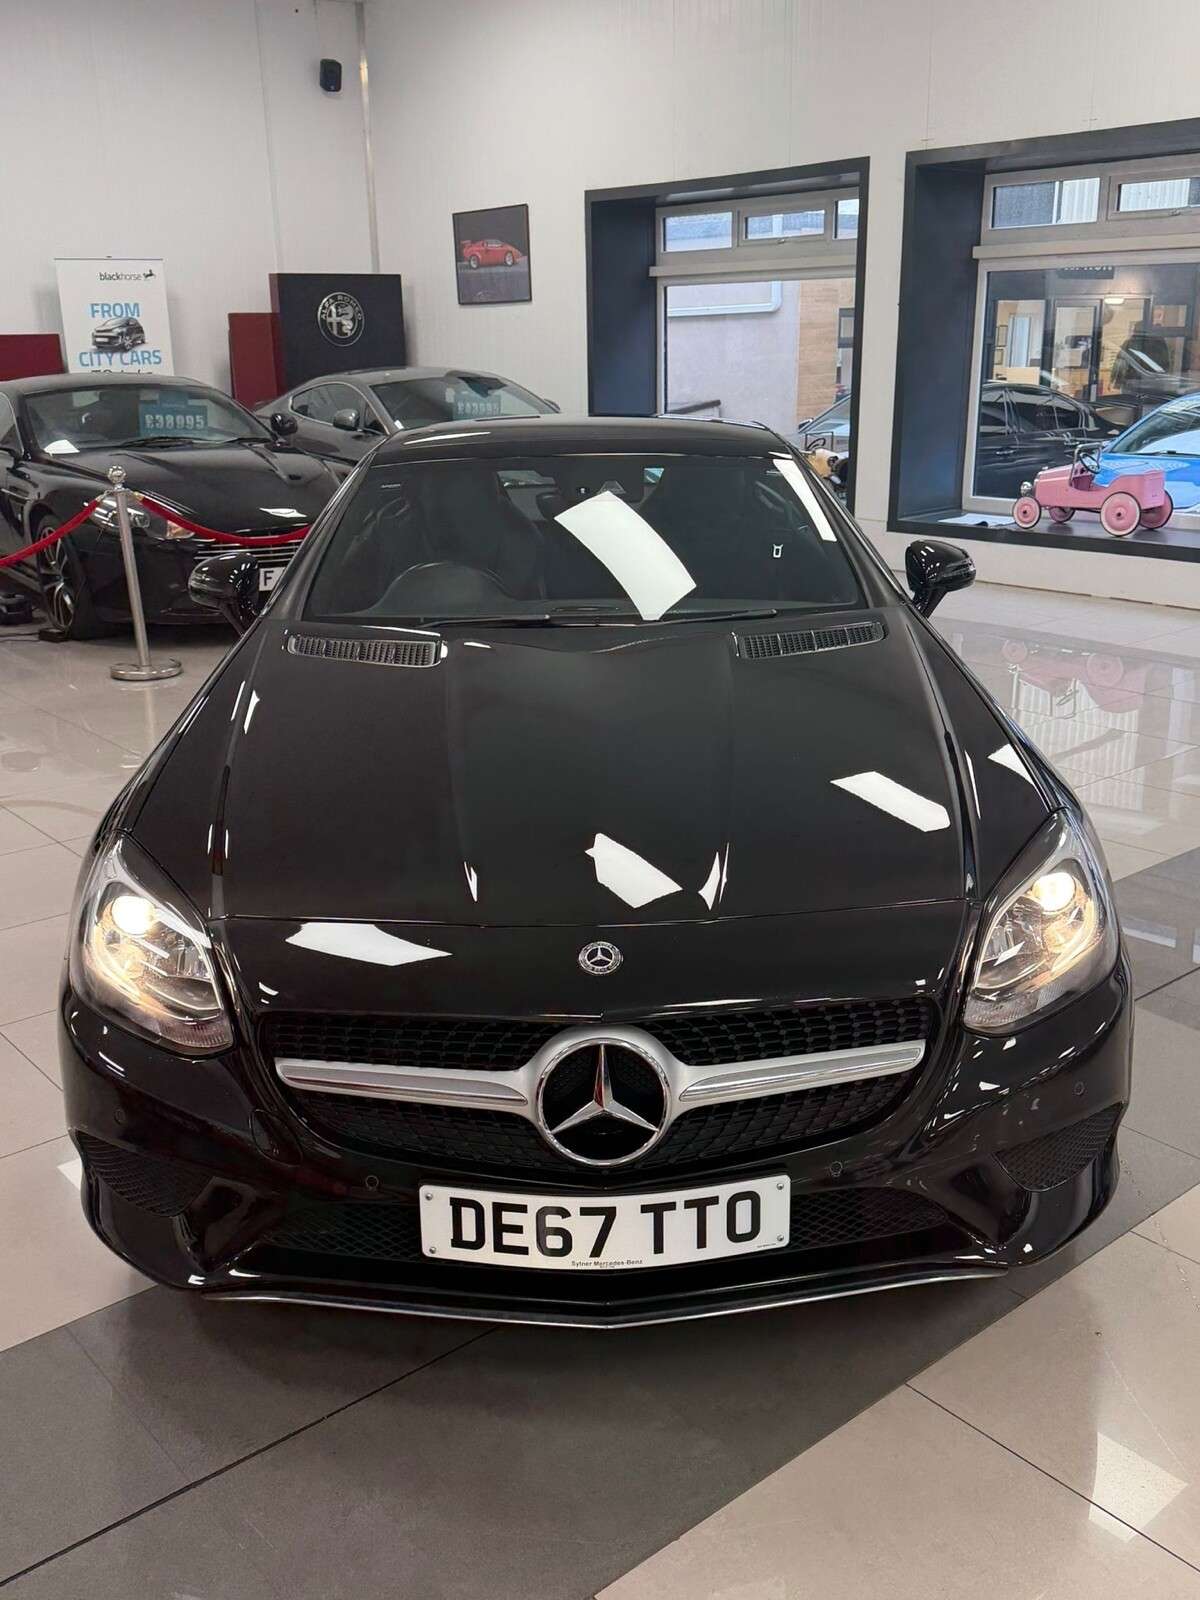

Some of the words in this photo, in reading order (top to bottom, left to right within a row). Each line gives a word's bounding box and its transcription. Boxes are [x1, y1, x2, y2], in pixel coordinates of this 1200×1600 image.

[90, 302, 141, 318] FROM
[78, 351, 116, 367] CITY
[119, 349, 163, 366] CARS
[450, 1196, 617, 1258] DE67
[640, 1190, 761, 1255] TTO
